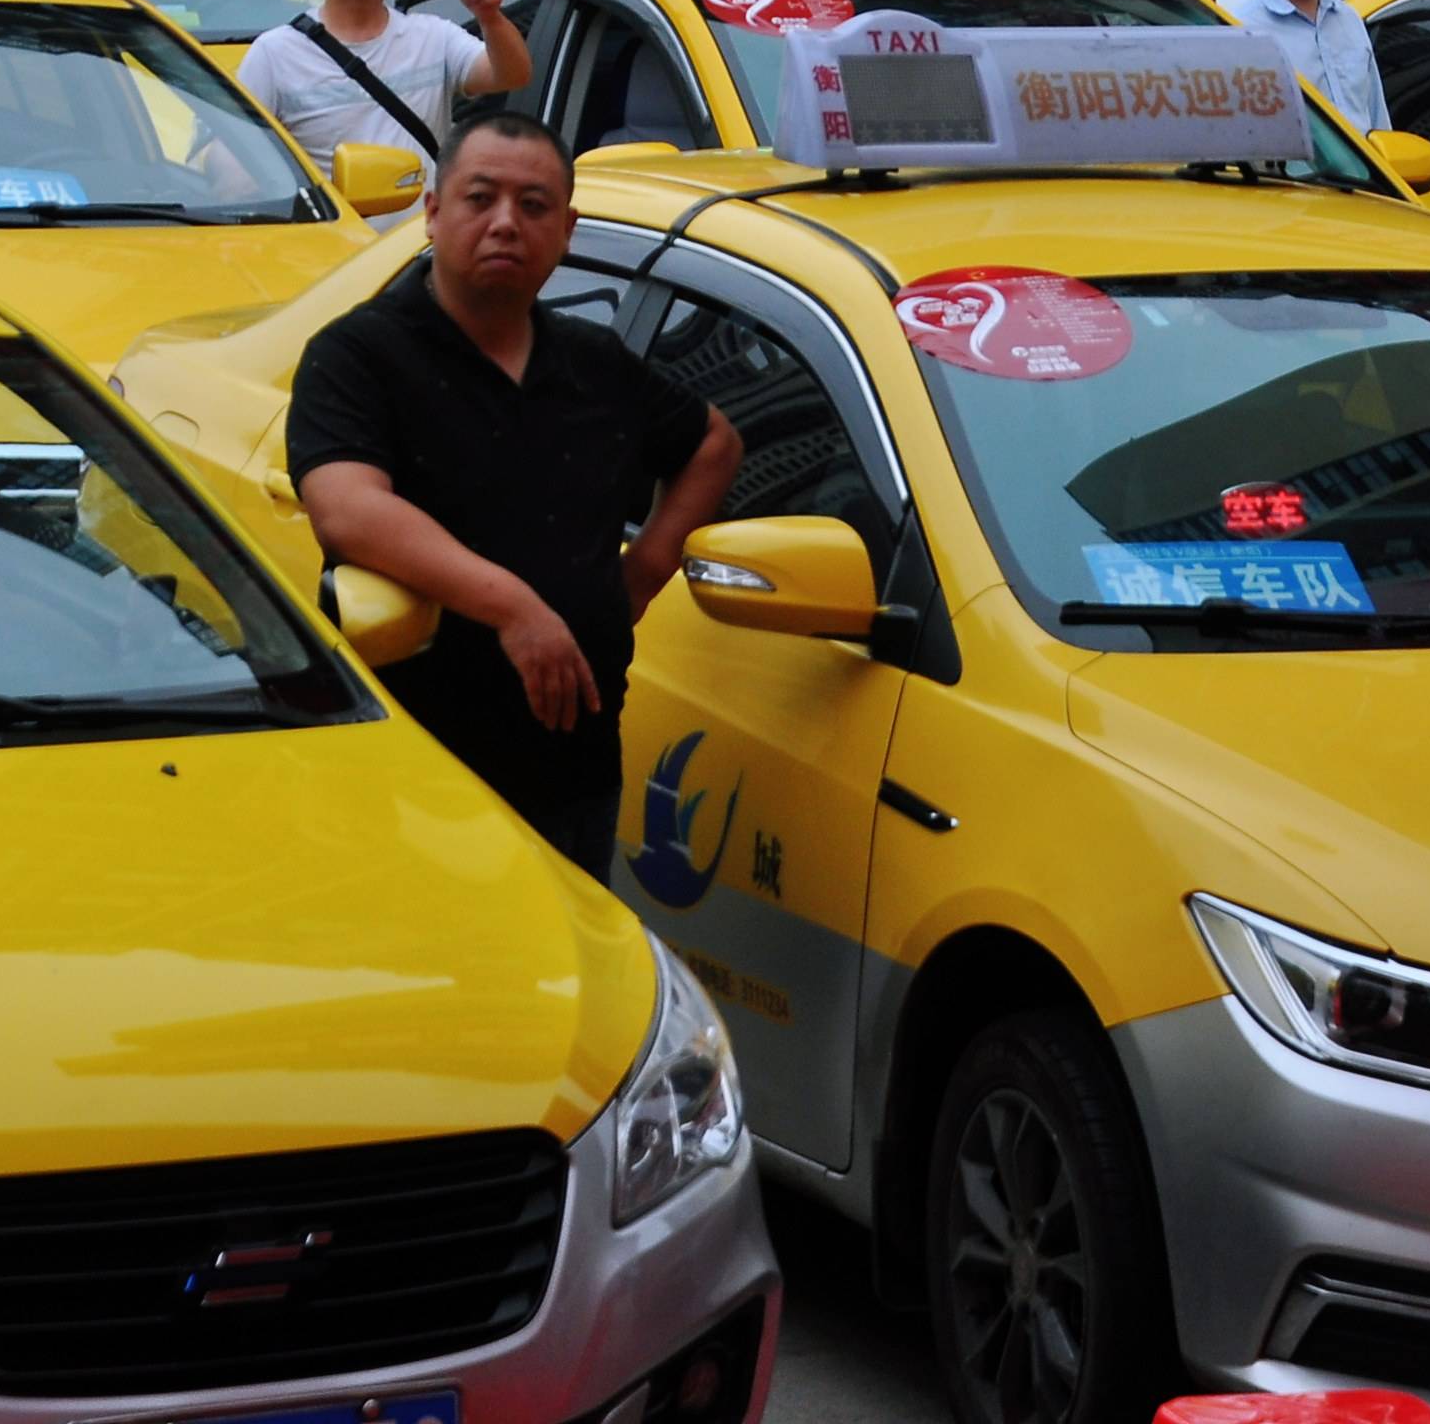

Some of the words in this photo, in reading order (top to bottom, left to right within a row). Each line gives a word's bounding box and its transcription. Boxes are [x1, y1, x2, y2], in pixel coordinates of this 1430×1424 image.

[867, 29, 941, 54] TAXI
[811, 64, 852, 142] 衡阳
[1015, 68, 1286, 122] 衡阳欢迎您
[1221, 489, 1306, 533] 空车
[1105, 561, 1363, 612] 诚信车队
